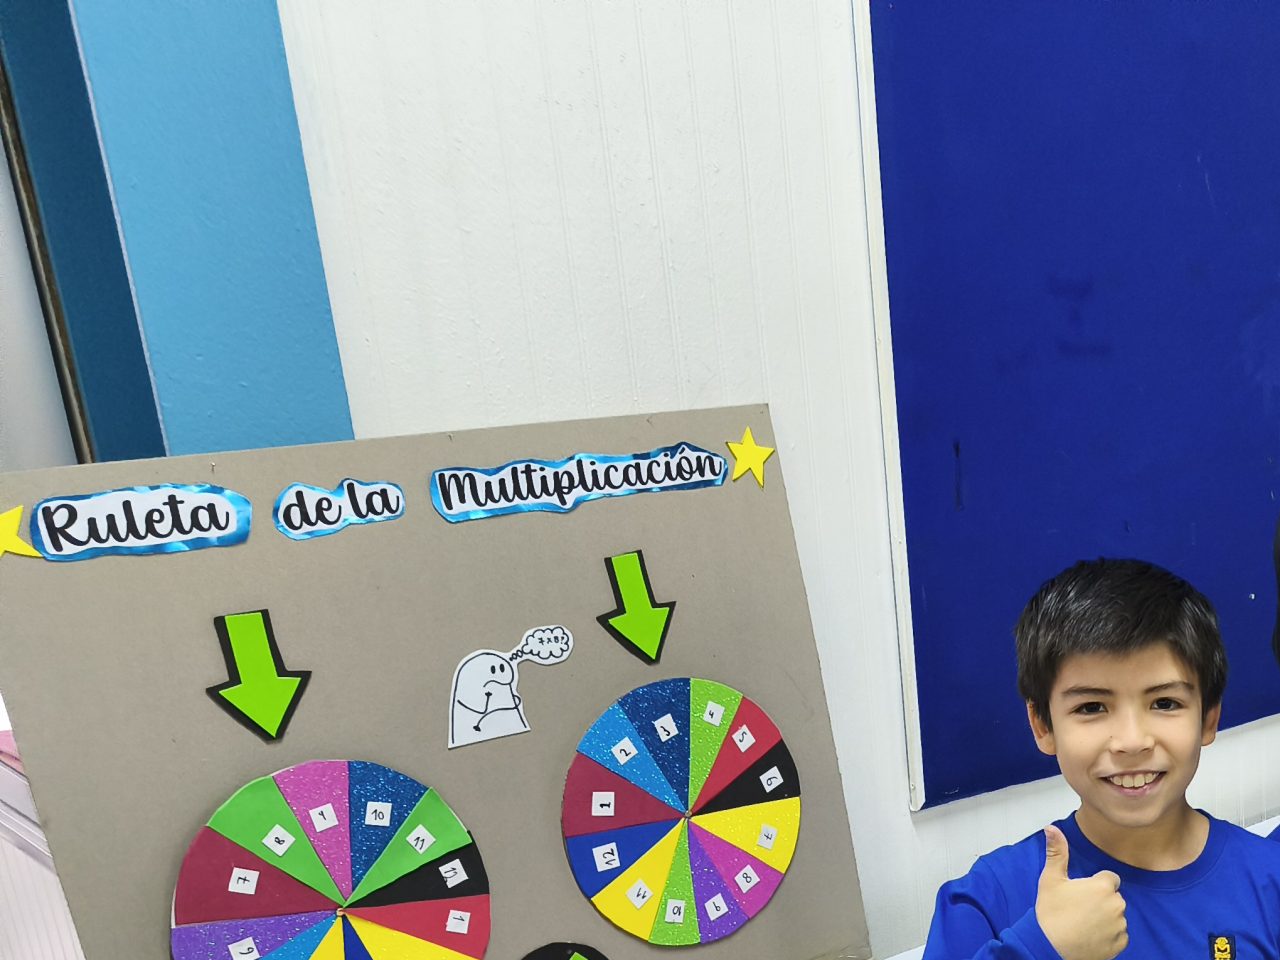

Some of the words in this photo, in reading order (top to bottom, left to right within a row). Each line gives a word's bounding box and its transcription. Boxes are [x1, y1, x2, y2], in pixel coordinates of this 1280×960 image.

[42, 494, 230, 552] Ruleta
[282, 490, 342, 532] de
[346, 482, 401, 519] la
[436, 448, 722, 511] Multiplicación
[620, 748, 632, 757] 2
[599, 801, 611, 809] 1
[371, 808, 384, 820] 10
[414, 836, 425, 850] 11
[603, 848, 616, 866] 12
[236, 876, 250, 884] 7
[742, 872, 752, 884] 8
